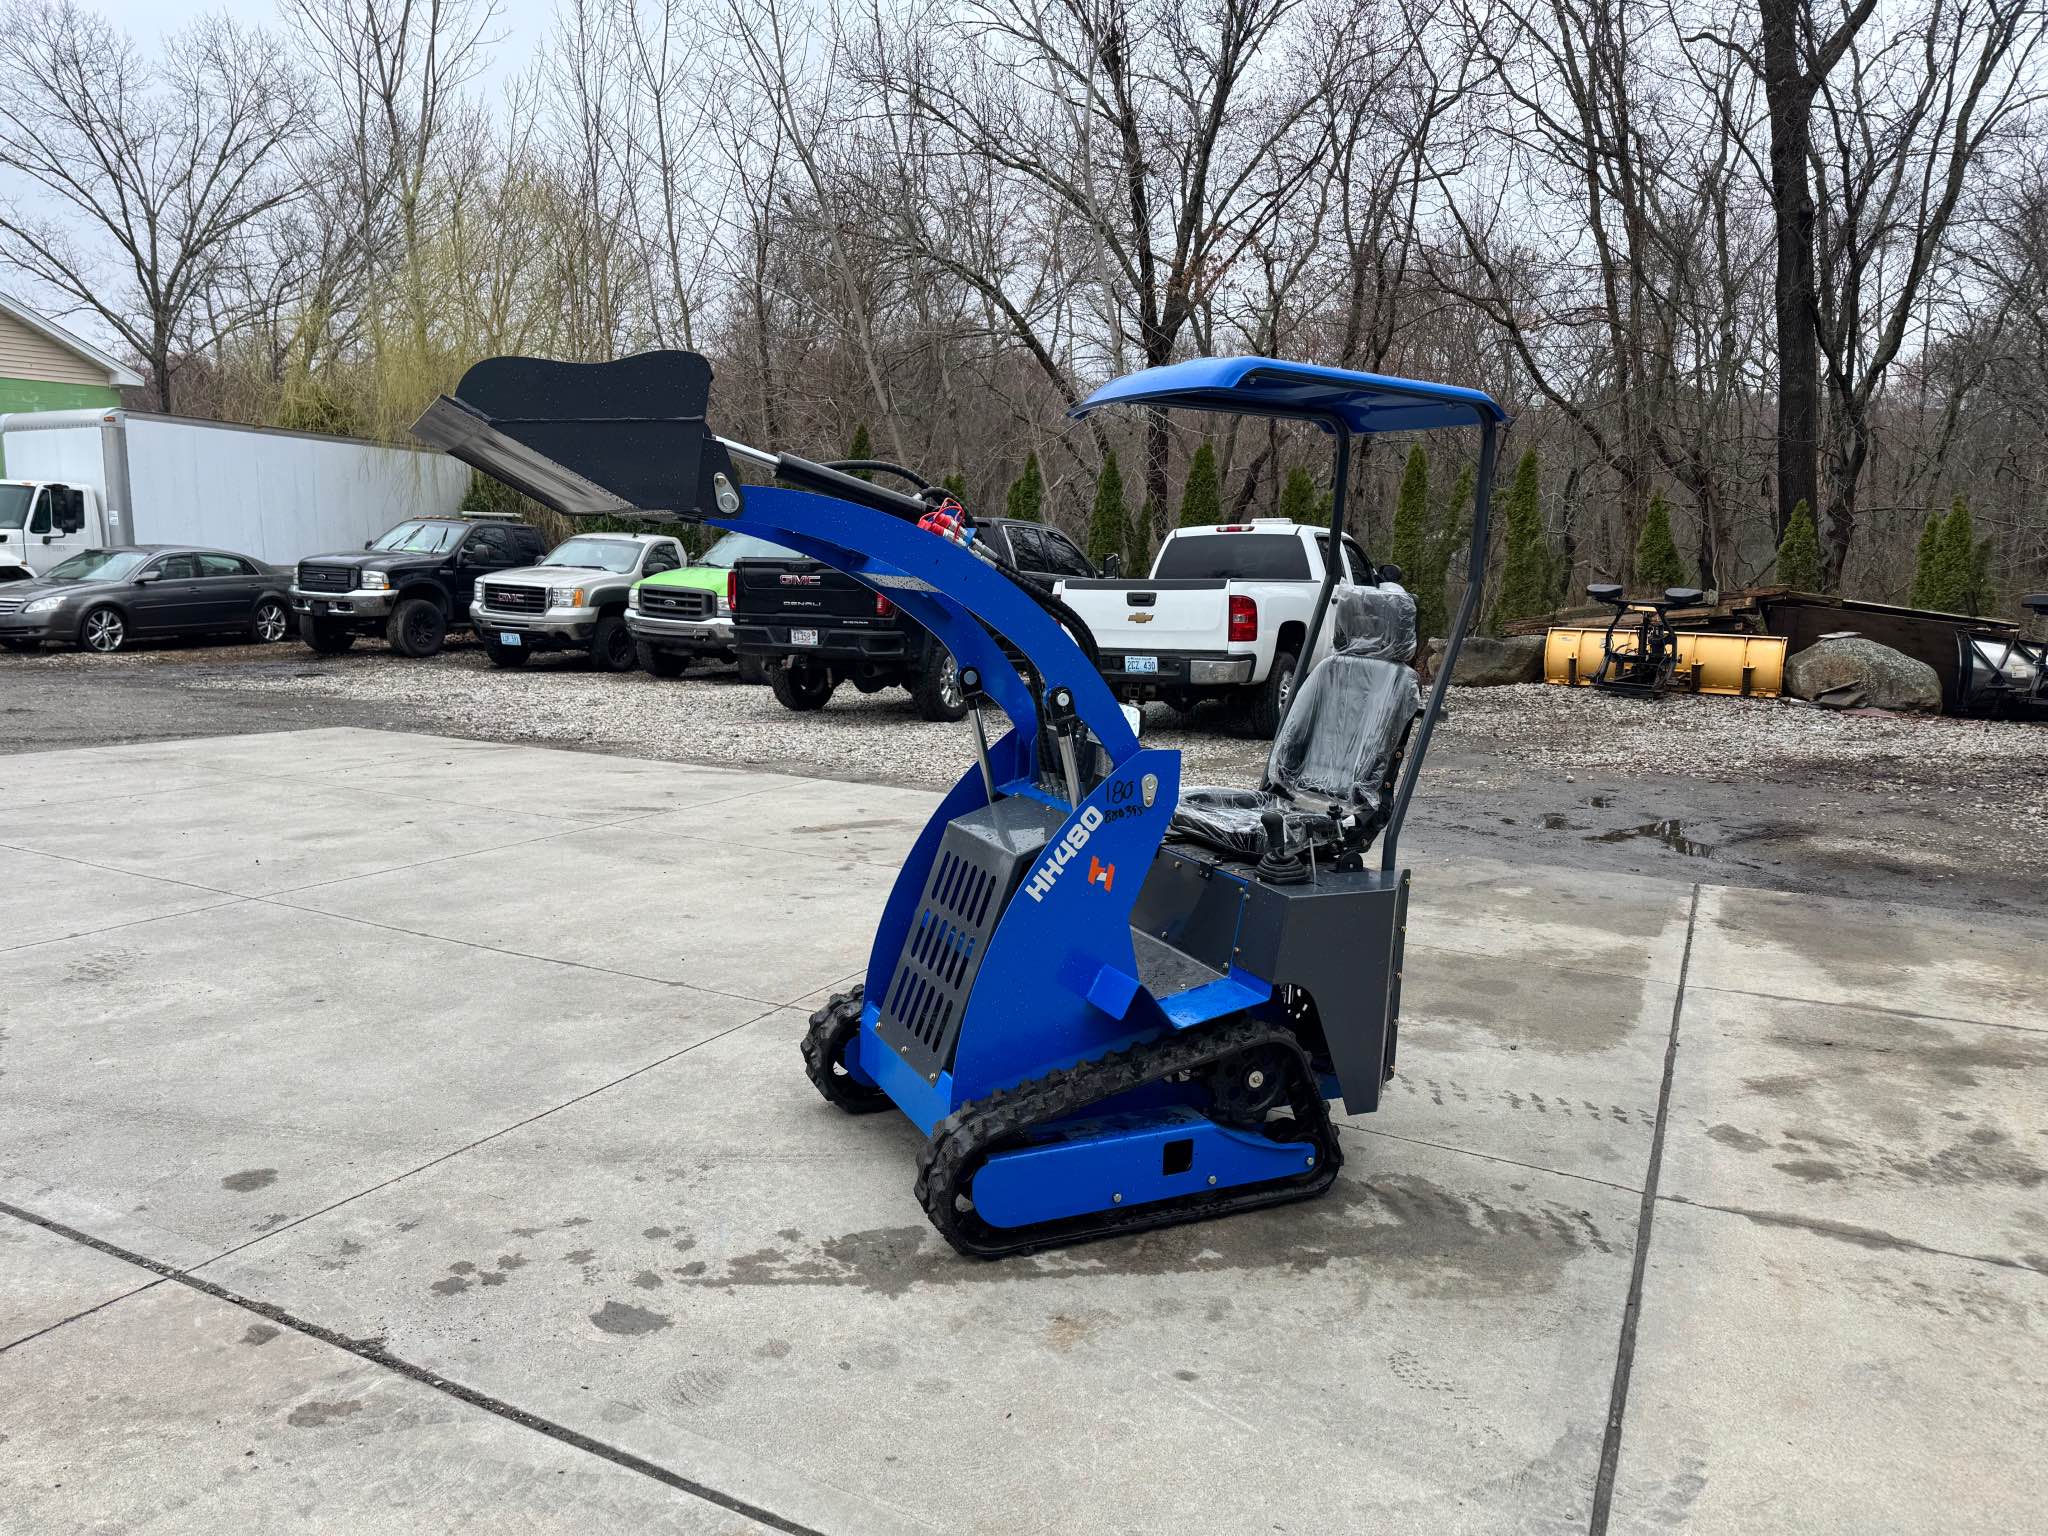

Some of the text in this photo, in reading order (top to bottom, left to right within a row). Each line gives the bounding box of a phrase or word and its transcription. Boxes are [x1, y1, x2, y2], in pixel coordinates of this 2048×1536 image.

[780, 574, 821, 585] GMC
[497, 592, 525, 604] GMC
[1106, 780, 1135, 804] 180
[1024, 805, 1104, 903] HH480
